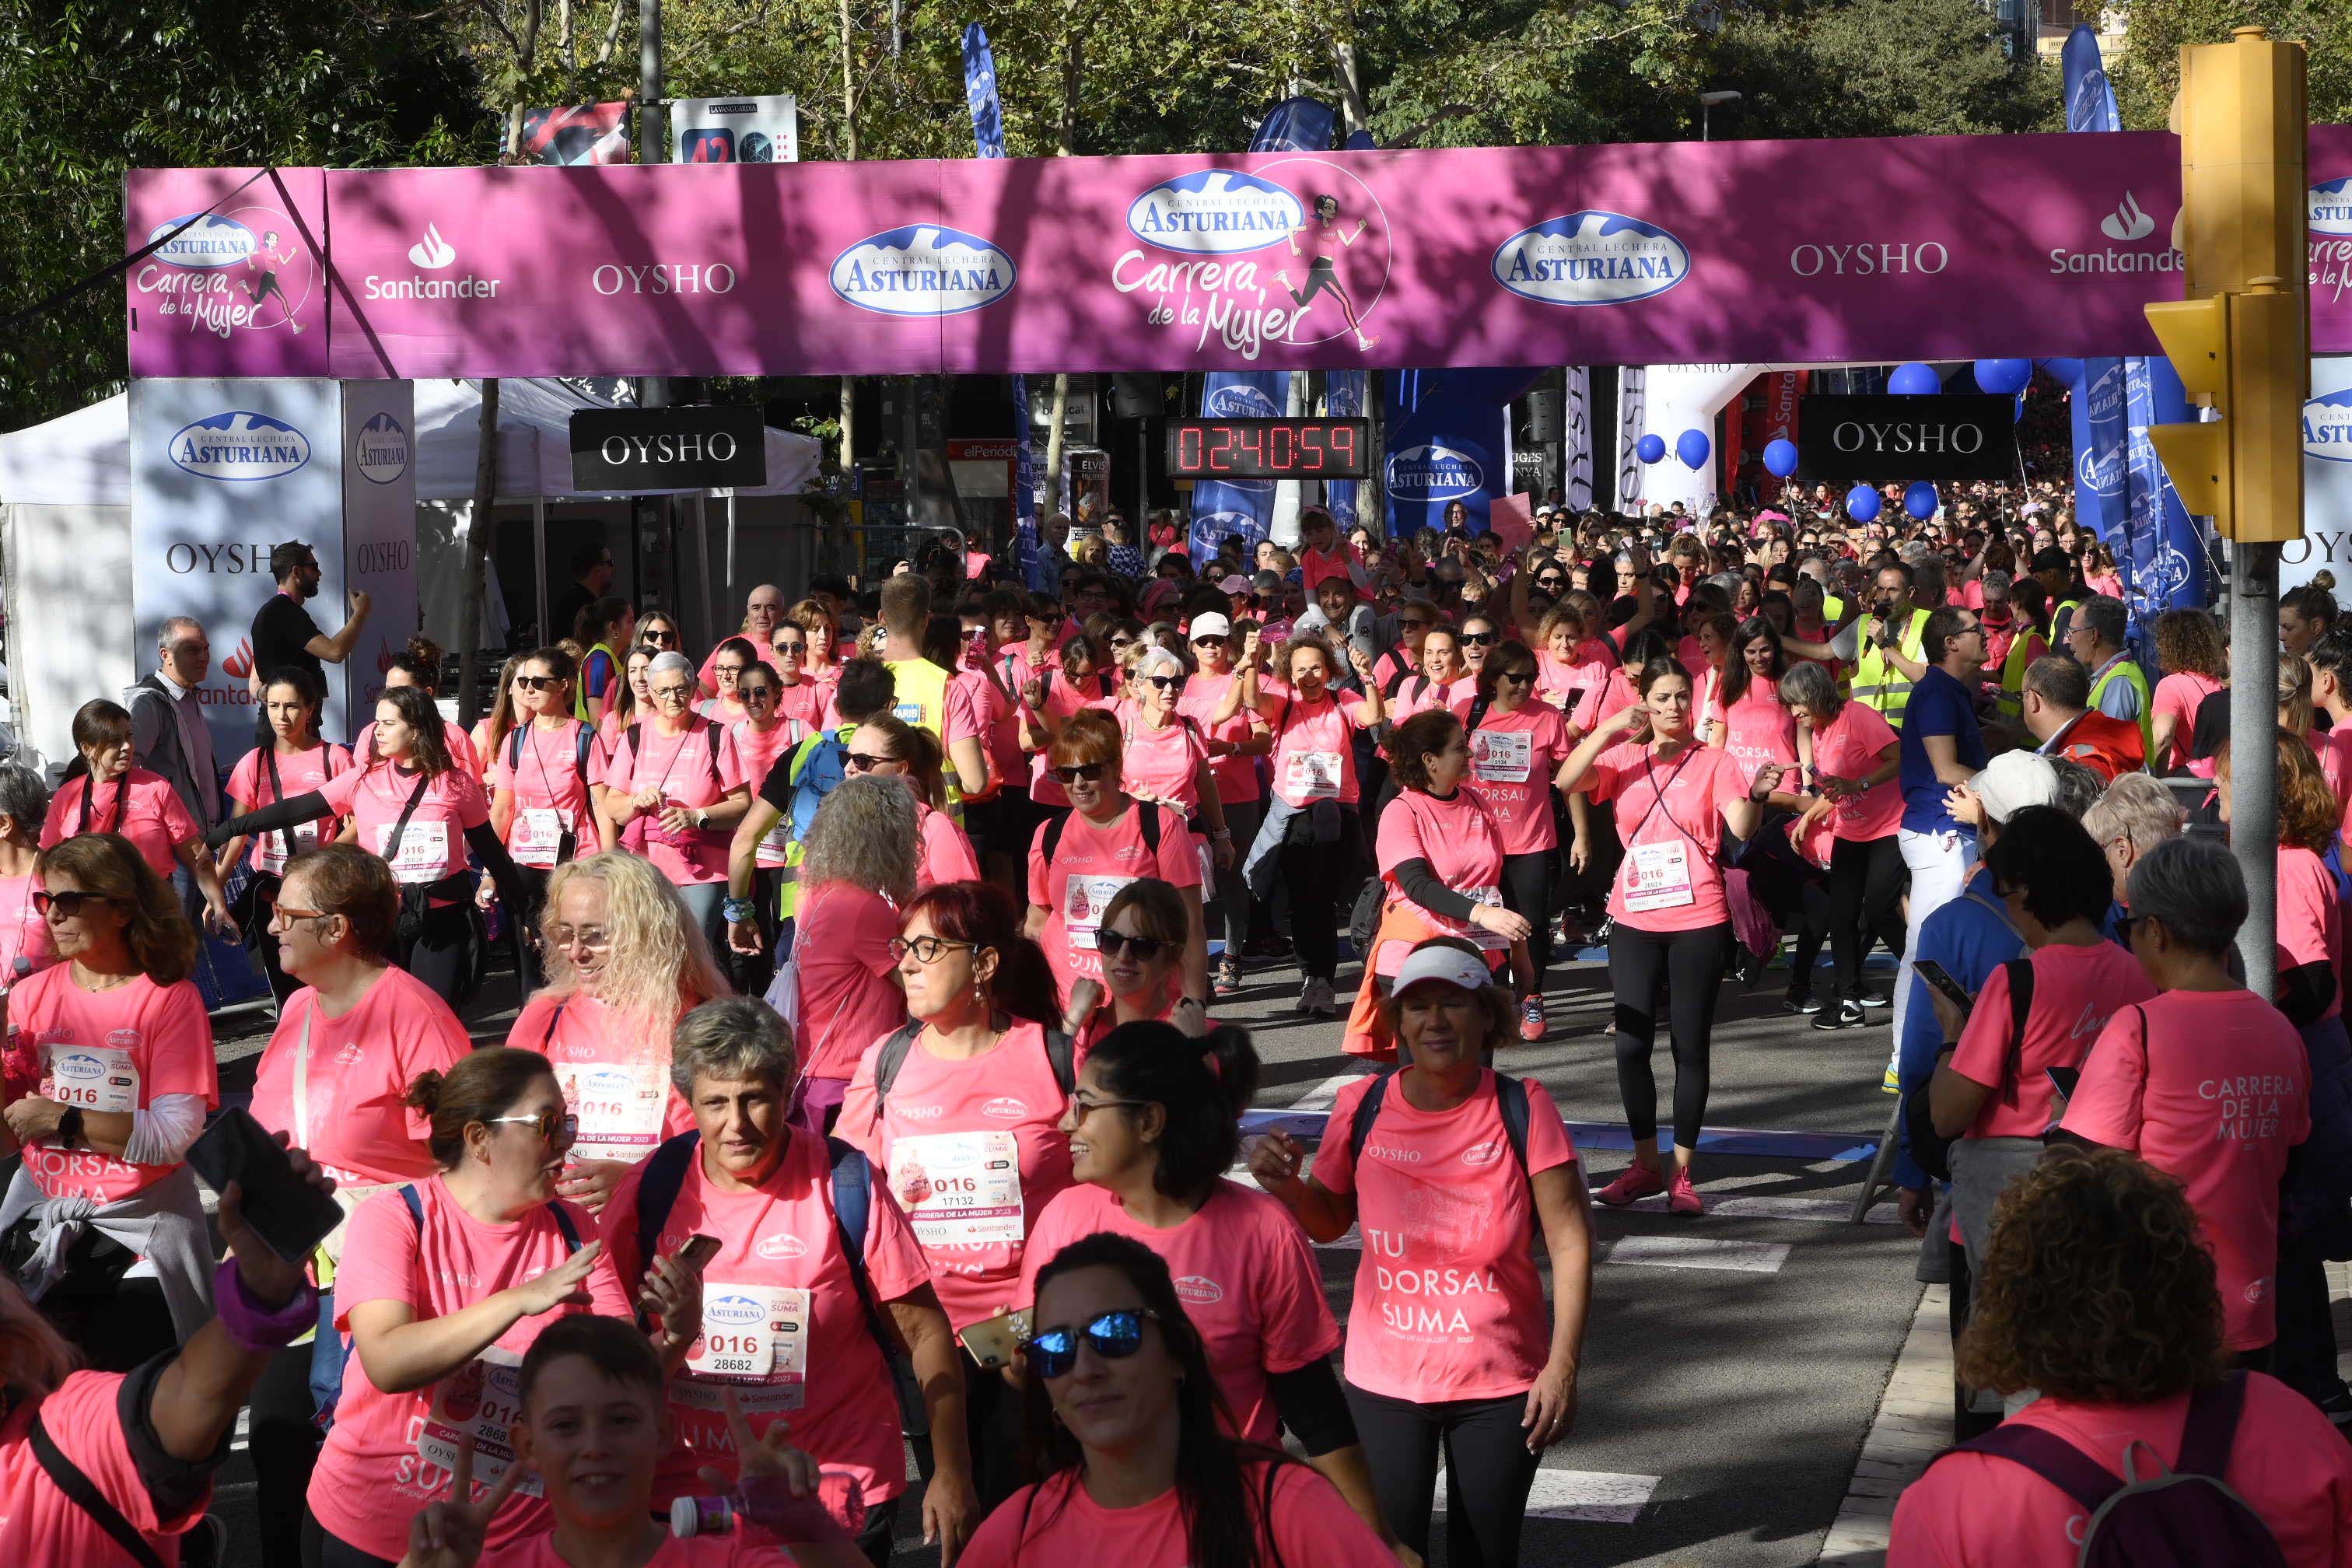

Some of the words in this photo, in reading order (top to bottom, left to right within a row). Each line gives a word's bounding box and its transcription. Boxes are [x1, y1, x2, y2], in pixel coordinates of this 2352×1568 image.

[1167, 198, 1221, 208] CENTRAL
[1228, 198, 1286, 207] LECHERA
[1140, 201, 1290, 233] ASTURIANA
[156, 232, 248, 254] ASTURIANA
[1537, 243, 1599, 254] CENTRAL
[1605, 242, 1668, 252] LECHERA
[872, 255, 932, 265] CENTRAL
[936, 254, 996, 264] LECHERA
[1507, 247, 1675, 282] ASTURIANA
[1790, 241, 1948, 276] OYSHO
[137, 264, 229, 293] Carrera
[592, 263, 736, 295] OYSHO
[843, 258, 1003, 292] ASTURIANA
[1111, 249, 1260, 292] Carrera
[2322, 263, 2336, 285] la
[364, 275, 500, 299] Santander
[159, 296, 177, 315] de
[180, 294, 193, 315] la
[190, 291, 263, 338] Mujer
[1147, 295, 1174, 325] de
[1181, 295, 1200, 325] la
[1196, 288, 1311, 361] Mujer
[201, 435, 247, 443] CENTRAL
[1832, 422, 1983, 453] OYSHO
[179, 437, 301, 464] ASTURIANA
[359, 439, 404, 467] ASTURIANA
[601, 432, 737, 465] OYSHO
[1180, 425, 1353, 470] 02:40:59
[1082, 460, 1106, 470] ELVIS
[1513, 467, 1542, 478] NYA
[1389, 467, 1477, 490] ASTURIANA
[357, 540, 409, 575] OYSHO
[1491, 750, 1511, 758] 016
[1728, 746, 1776, 758] DORSAL
[1305, 768, 1323, 776] 016
[516, 796, 532, 809] TU
[533, 830, 553, 838] 016
[1062, 856, 1093, 864] OYSHO
[1641, 869, 1664, 880] 016
[60, 1061, 102, 1076] ASTURIANA
[110, 1063, 134, 1072] SUMA
[58, 1087, 98, 1103] 016
[2198, 1076, 2294, 1100] CARRERA
[583, 1101, 623, 1116] 016
[894, 1106, 943, 1120] OYSHO
[985, 1104, 1027, 1116] ASTURIANA
[2222, 1097, 2251, 1118] DE
[2257, 1097, 2280, 1117] LA
[2217, 1118, 2279, 1141] MUJER
[1368, 1146, 1421, 1164] OYSHO
[933, 1177, 977, 1193] 016
[941, 1195, 975, 1207] 17132
[913, 1210, 945, 1220] CARRERA
[946, 1209, 956, 1218] DE
[957, 1209, 967, 1217] LA
[968, 1208, 992, 1217] MUJER
[994, 1207, 1012, 1216] 2023
[913, 1226, 947, 1237] OYSHO
[977, 1222, 1017, 1234] Santander
[1367, 1228, 1405, 1258] TU
[1376, 1265, 1500, 1297] DORSAL
[709, 1305, 761, 1319] ASTURIANA
[771, 1304, 798, 1313] SUMA
[1381, 1301, 1470, 1334] SUMA
[709, 1335, 758, 1354] 016
[1456, 1335, 1475, 1345] 2023
[714, 1359, 752, 1371] 28682
[751, 1393, 794, 1404] Santander
[478, 1423, 510, 1443] 2868
[476, 1442, 488, 1451] DE
[391, 1482, 424, 1501] CARRERA
